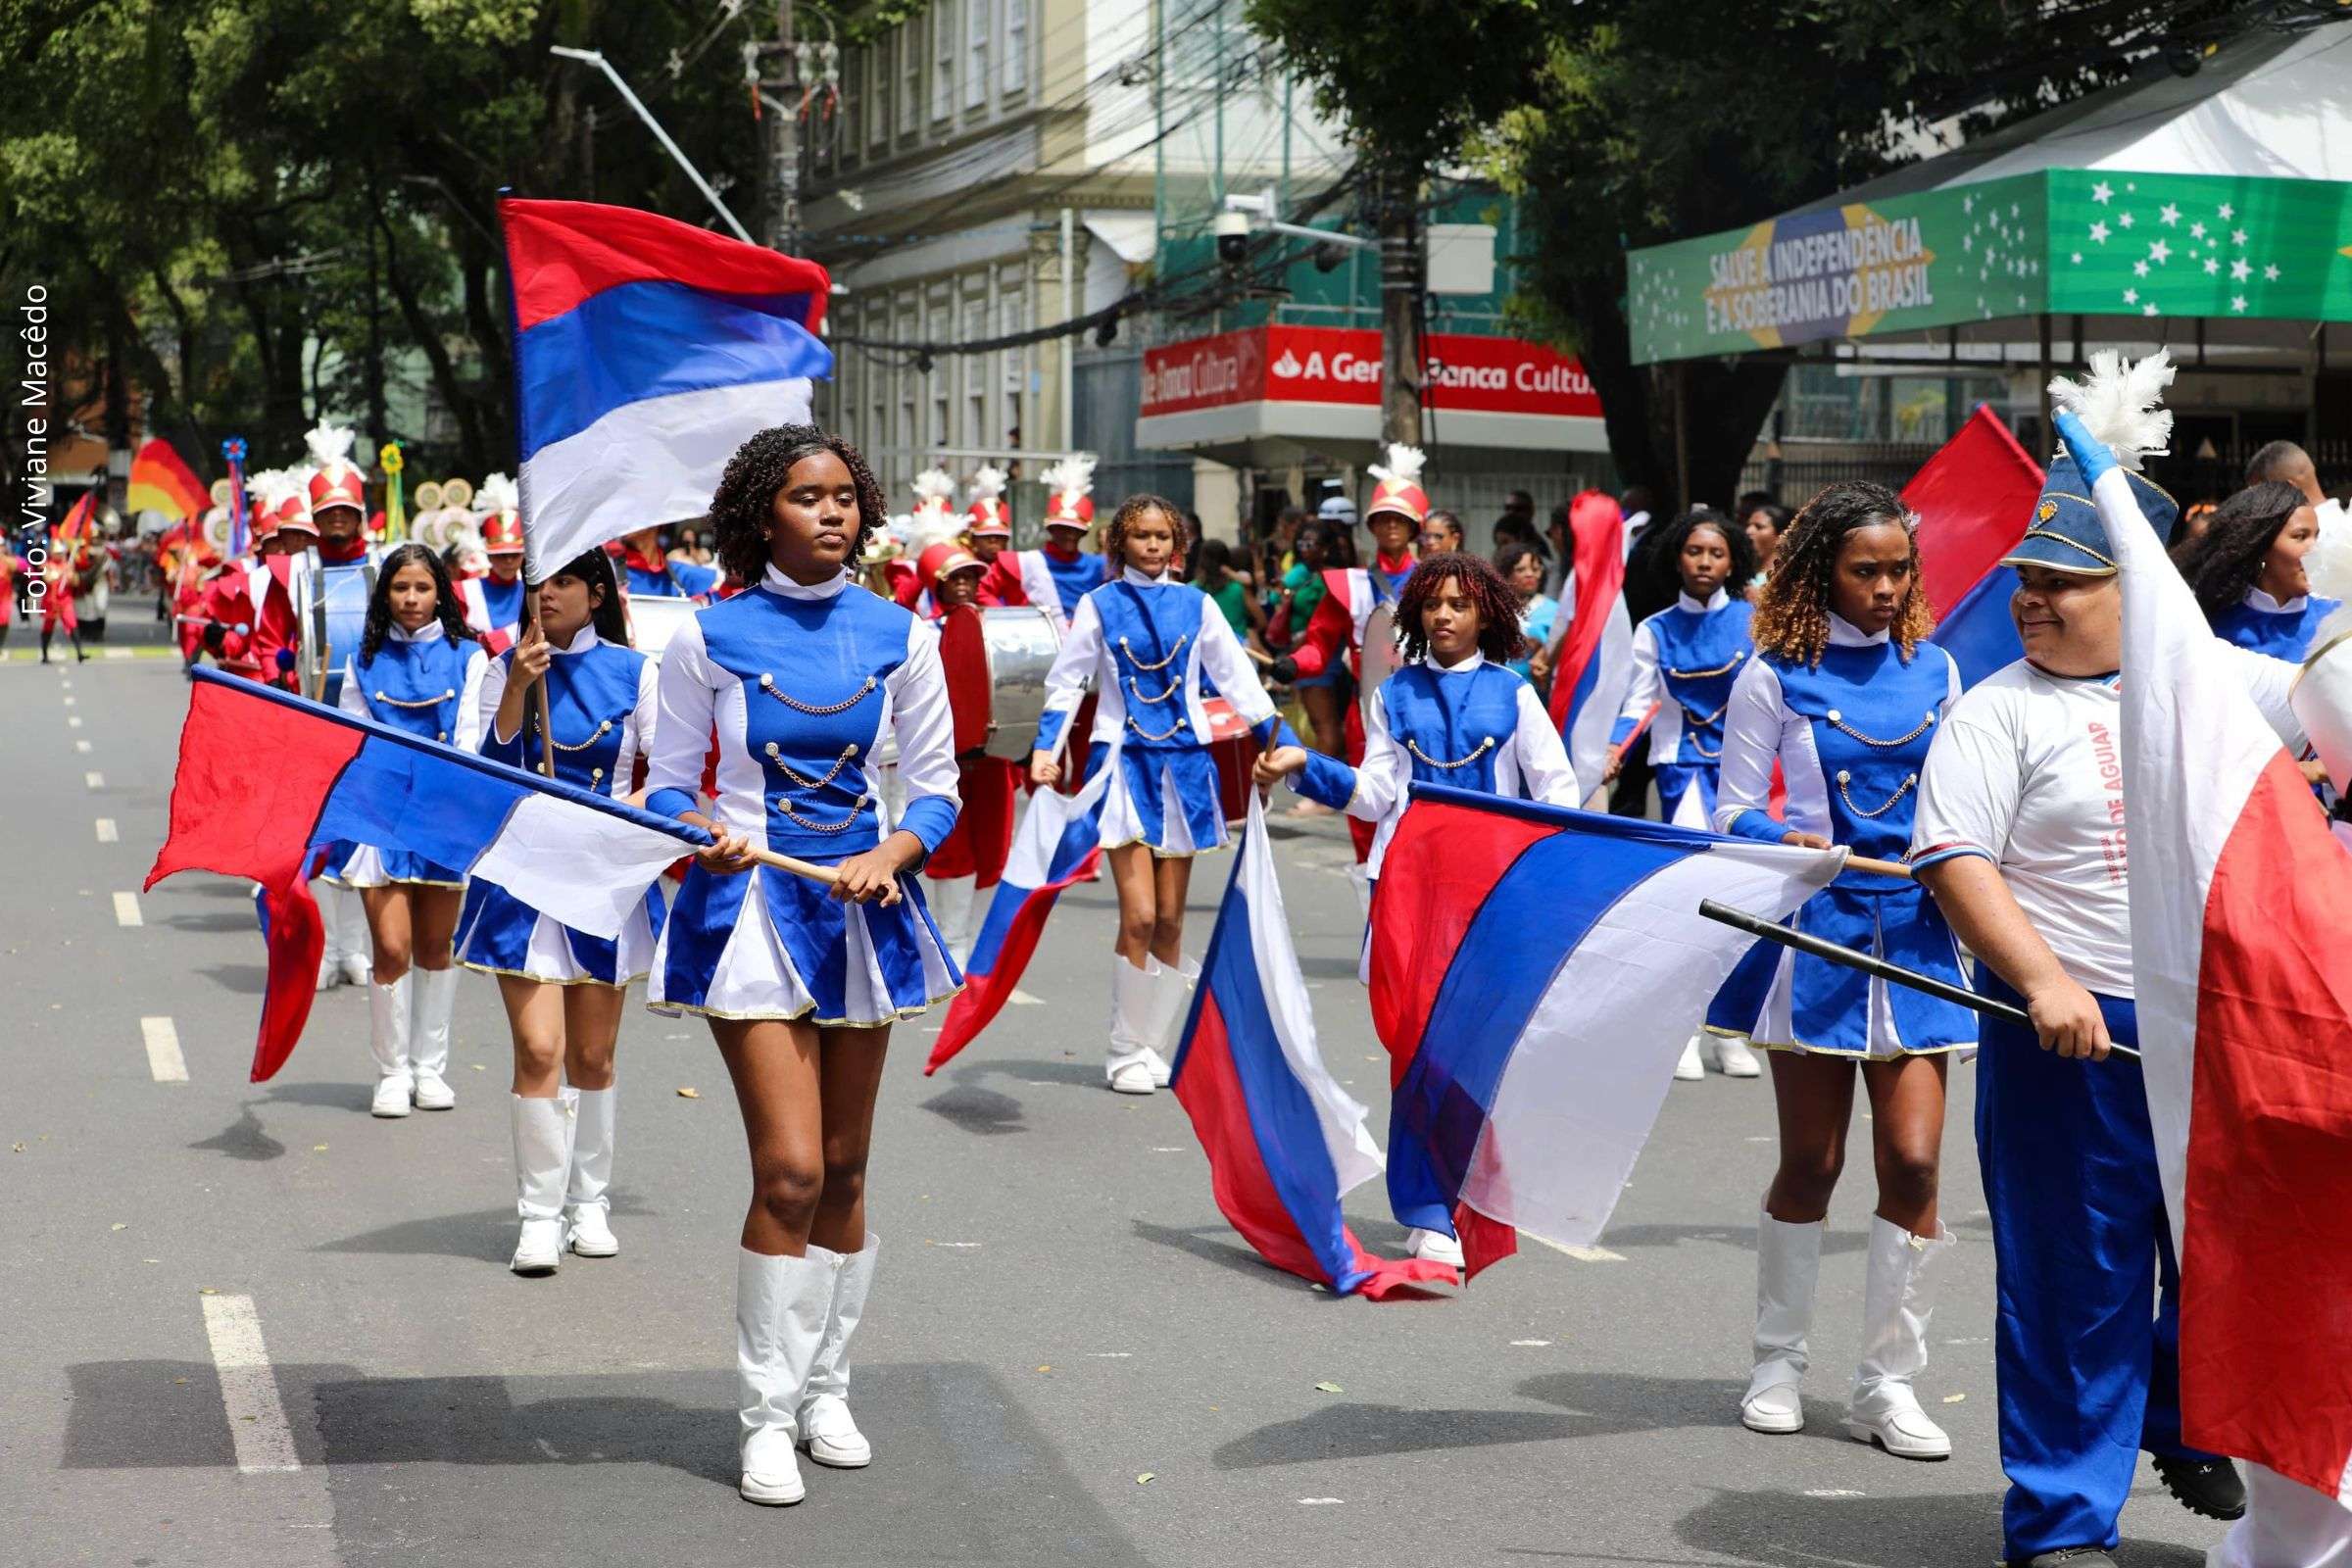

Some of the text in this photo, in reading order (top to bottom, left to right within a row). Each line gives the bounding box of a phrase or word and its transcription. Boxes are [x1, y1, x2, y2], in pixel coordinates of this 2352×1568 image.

[1709, 215, 1923, 288] SALVE A INDEPENDÊNCIA
[1706, 263, 1934, 334] E A SOBERANIA DO BRASIL
[1303, 351, 1326, 380] A
[1514, 362, 1596, 395] Cultu
[2088, 721, 2124, 791] AGUIAR
